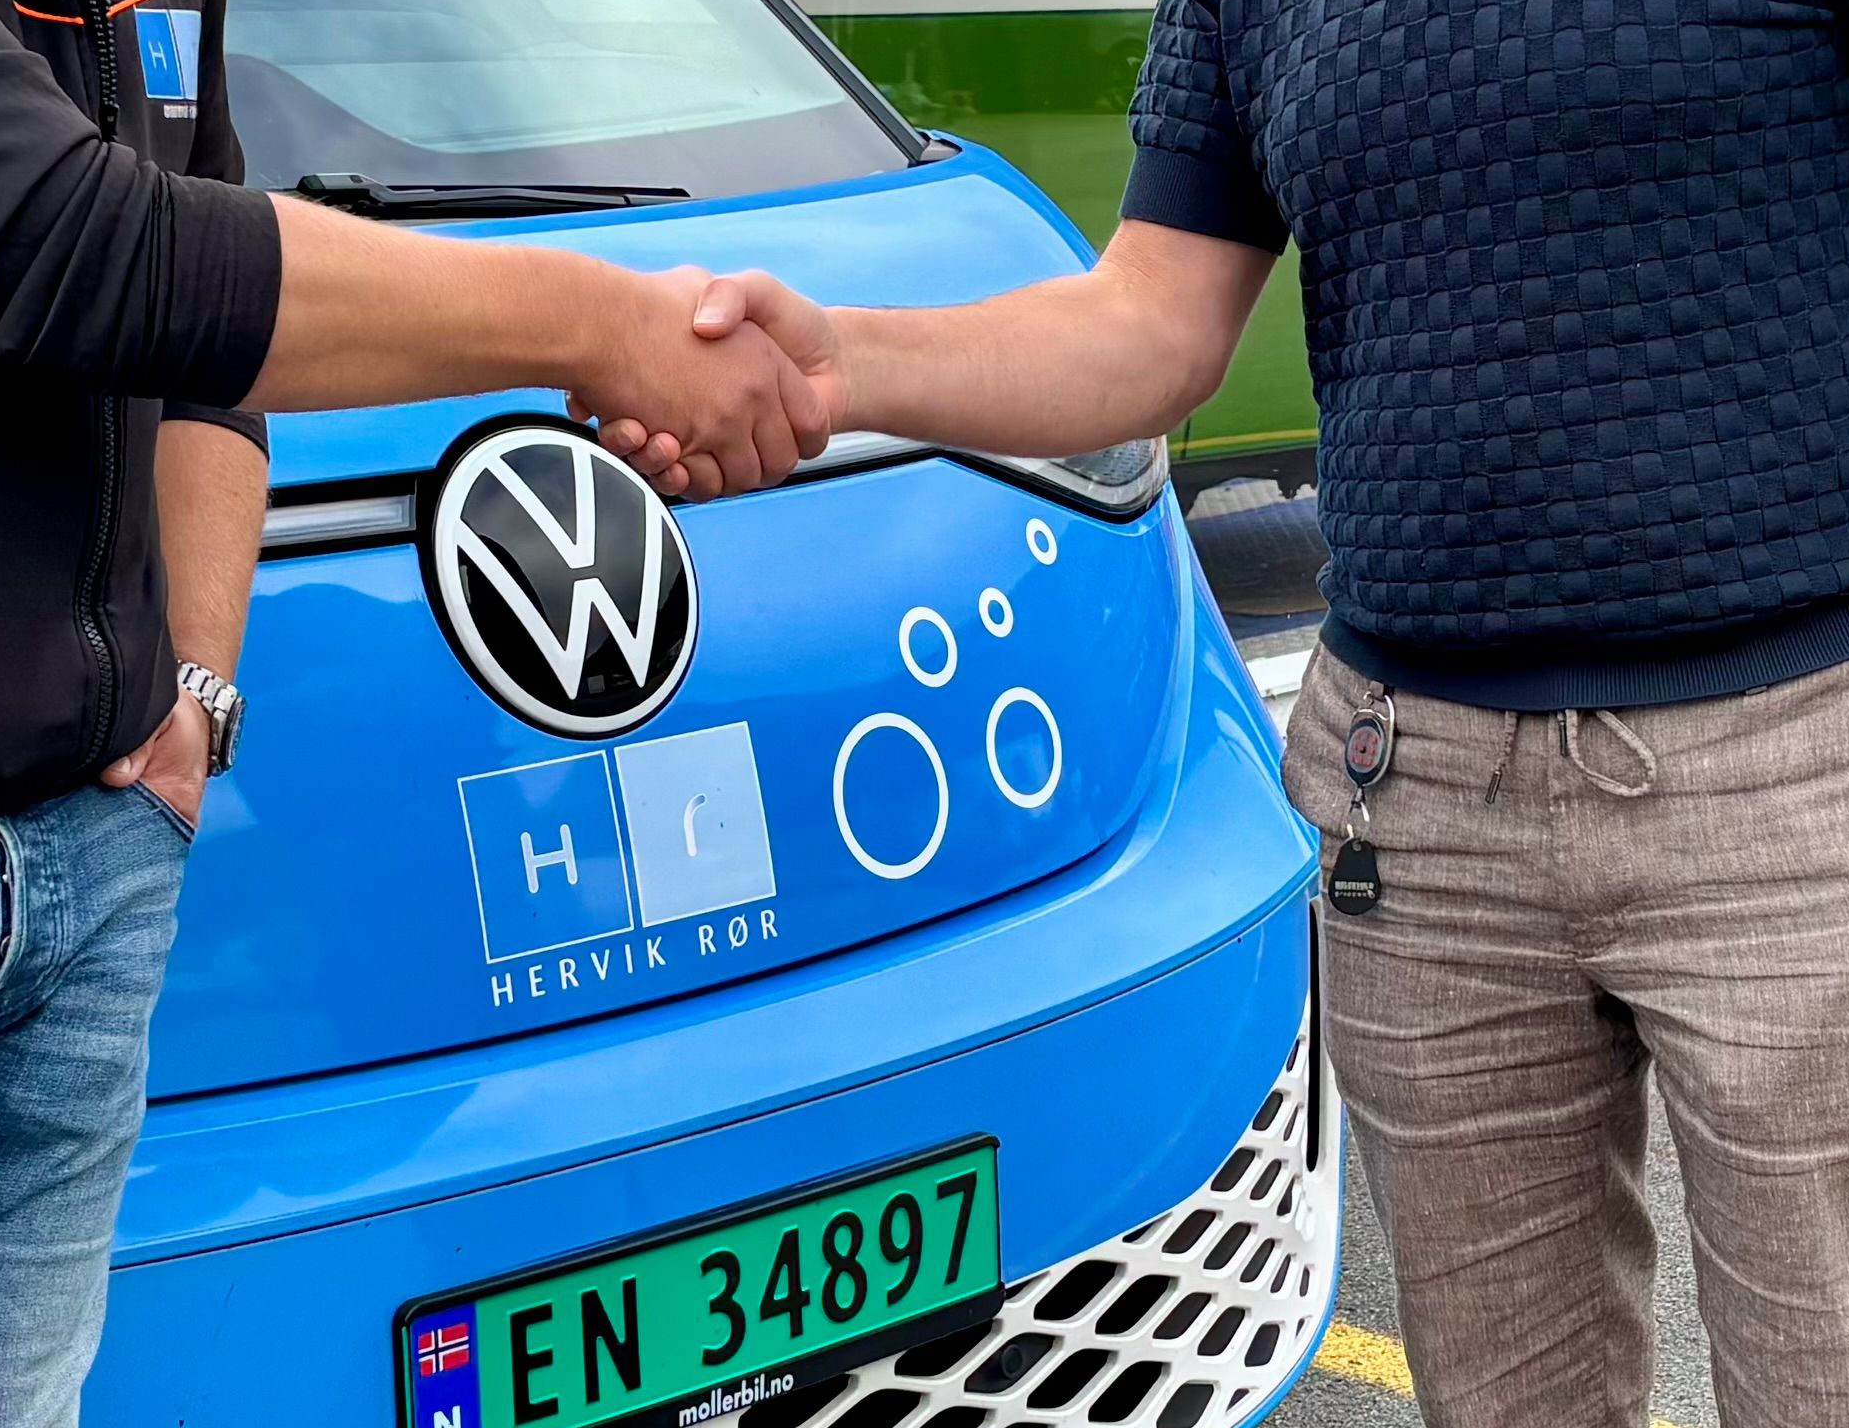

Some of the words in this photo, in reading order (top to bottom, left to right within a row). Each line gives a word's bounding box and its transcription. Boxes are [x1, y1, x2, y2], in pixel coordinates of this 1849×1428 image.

[520, 824, 579, 894] H
[491, 935, 668, 1008] HERVIK
[698, 908, 781, 959] RØR
[509, 1276, 643, 1428] EN
[698, 1169, 978, 1368] 34897
[678, 1372, 795, 1428] mollerbil.no
